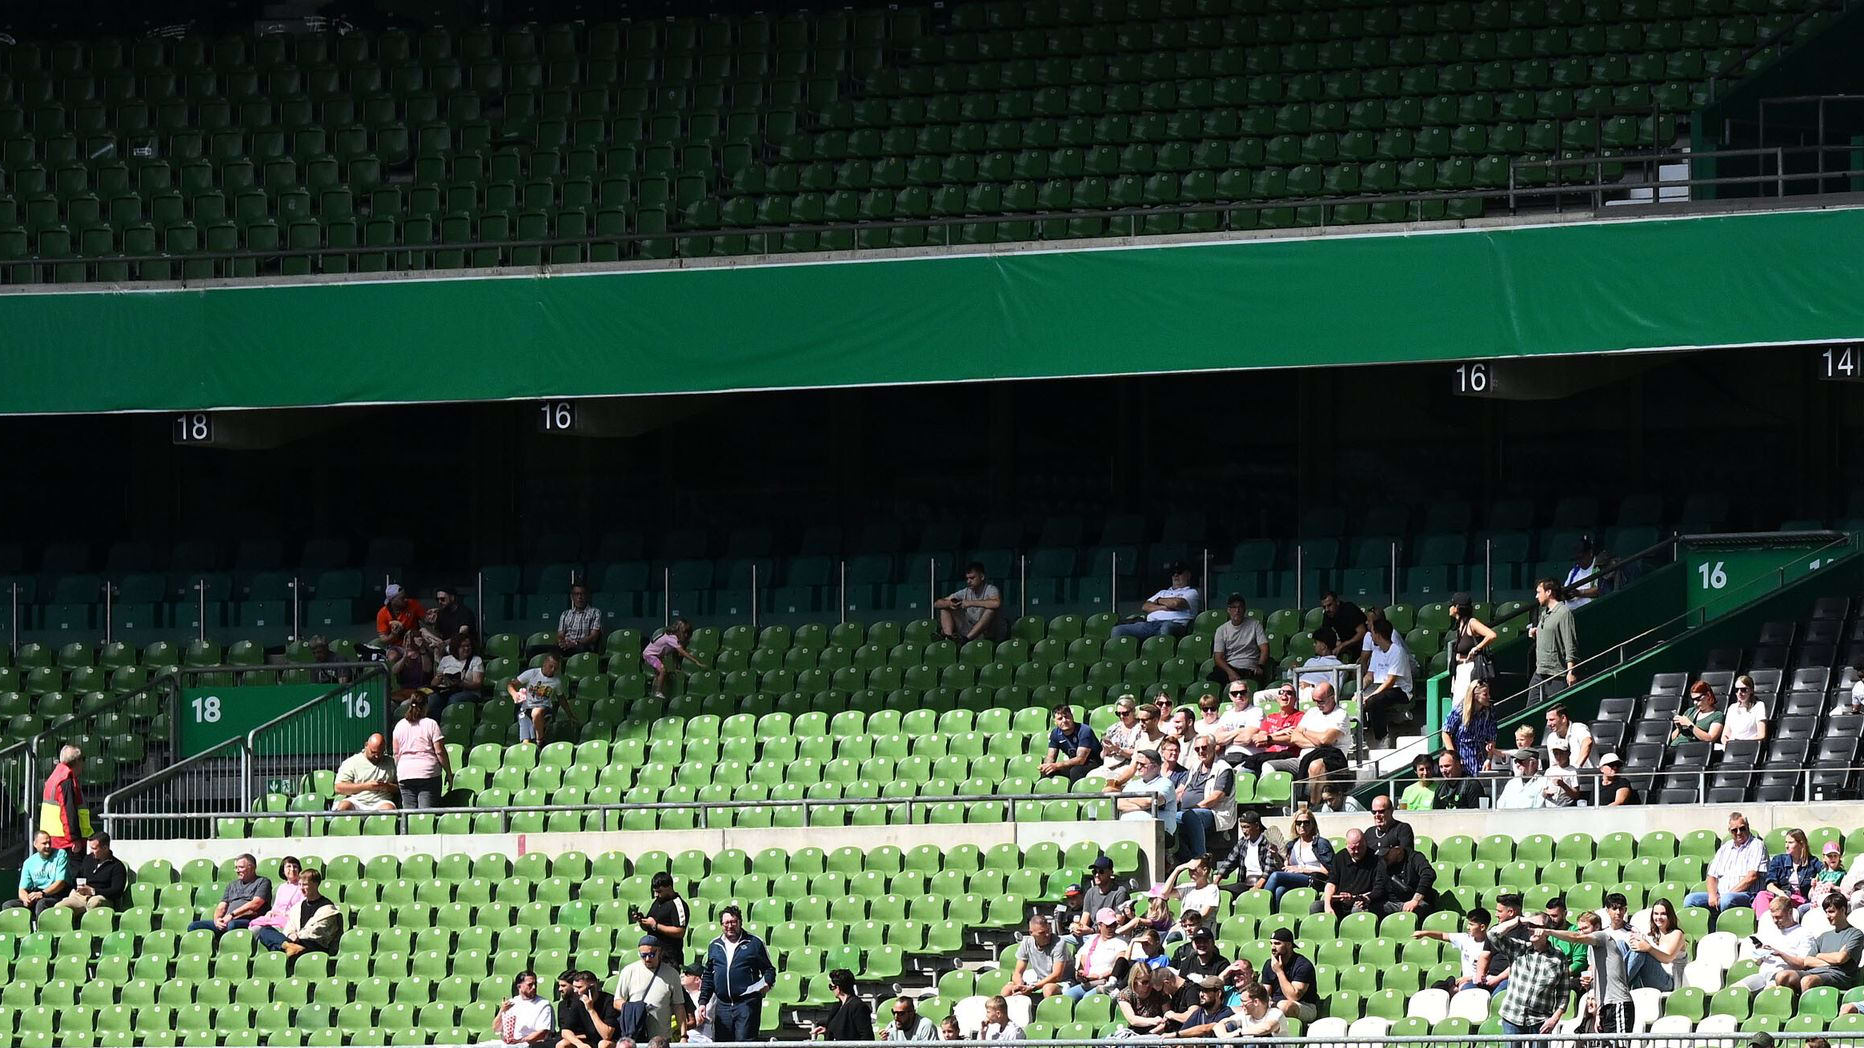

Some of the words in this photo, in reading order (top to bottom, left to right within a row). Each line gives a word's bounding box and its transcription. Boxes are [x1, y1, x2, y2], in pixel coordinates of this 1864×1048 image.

[1823, 347, 1855, 377] 14
[1456, 363, 1486, 393] 16
[176, 414, 208, 440] 18
[541, 402, 571, 430] 16
[1699, 561, 1727, 589] 16
[191, 696, 221, 723] 18
[342, 692, 371, 718] 16
